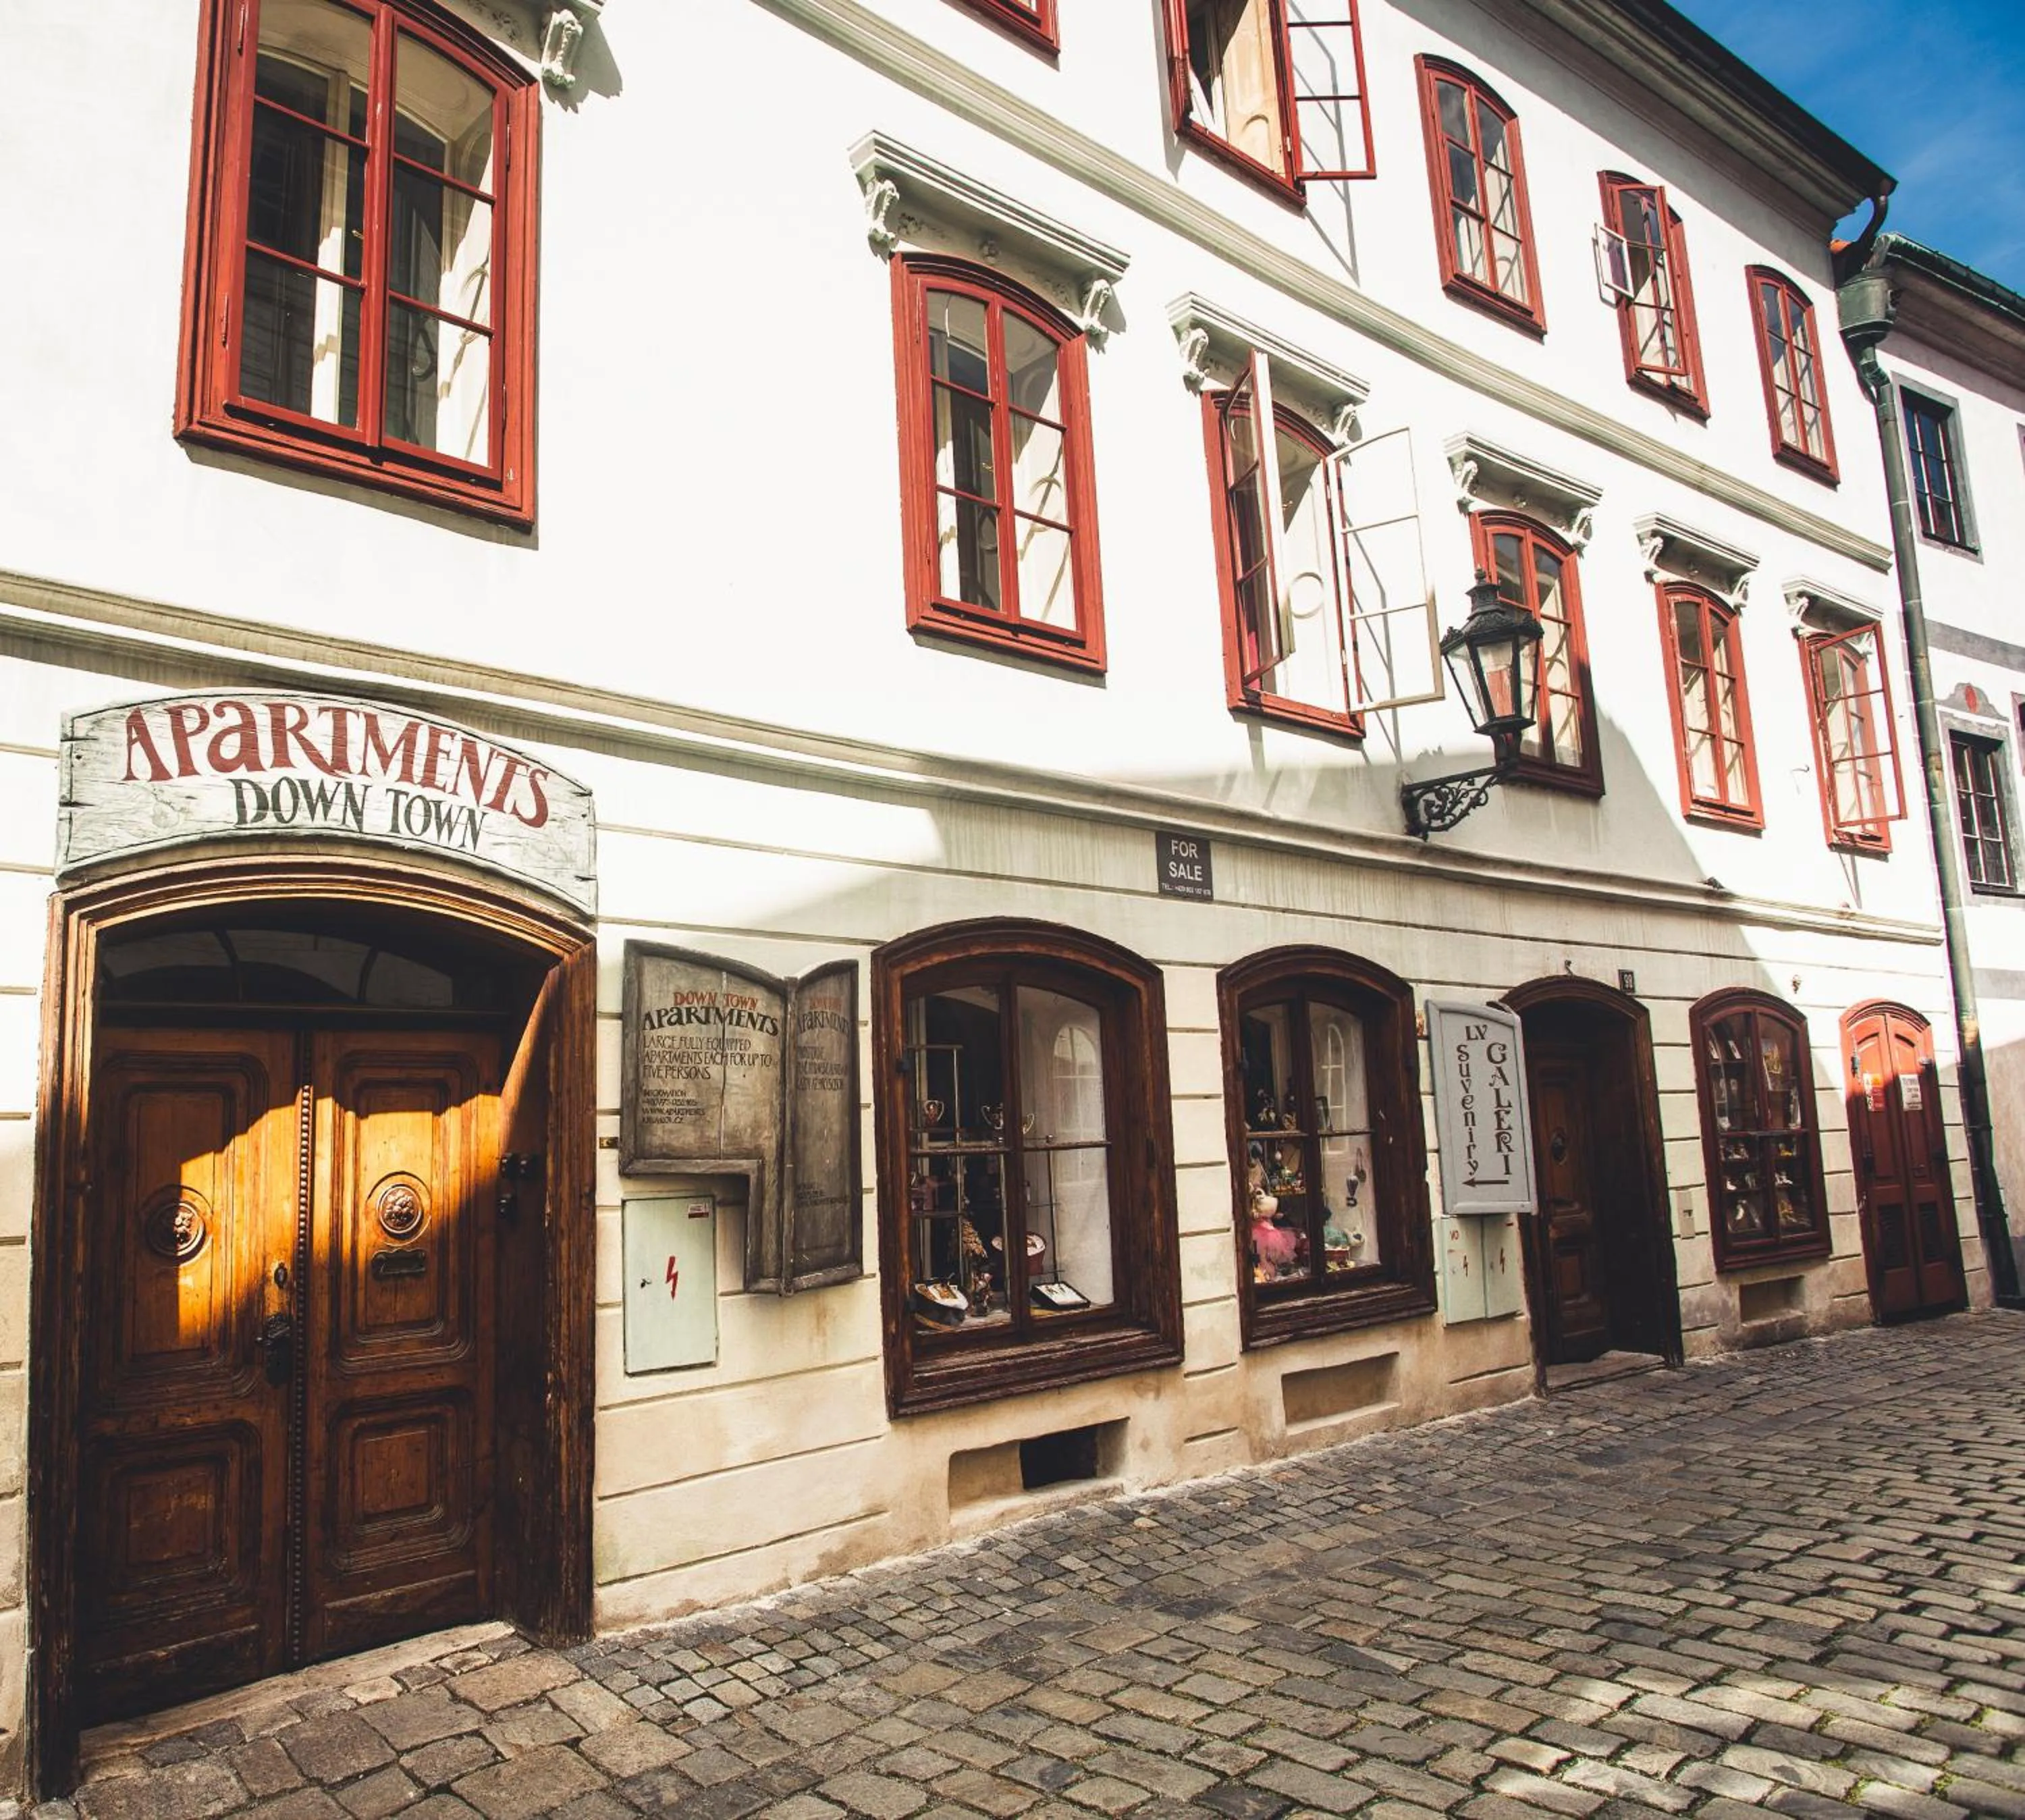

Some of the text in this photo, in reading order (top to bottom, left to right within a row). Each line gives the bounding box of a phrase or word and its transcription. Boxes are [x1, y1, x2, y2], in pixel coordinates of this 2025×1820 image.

[228, 776, 489, 852] DOWN TOWN
[1171, 839, 1198, 859] FOR
[1168, 861, 1203, 881] SALE
[674, 991, 758, 1010] DOWN TOWN
[643, 1050, 703, 1064] APARTMENTS
[730, 1053, 747, 1066] FOR
[747, 1054, 760, 1067] UP
[761, 1053, 773, 1067] TO
[643, 1066, 711, 1080] FIVE PERSONS
[1486, 1042, 1515, 1175] GALERI
